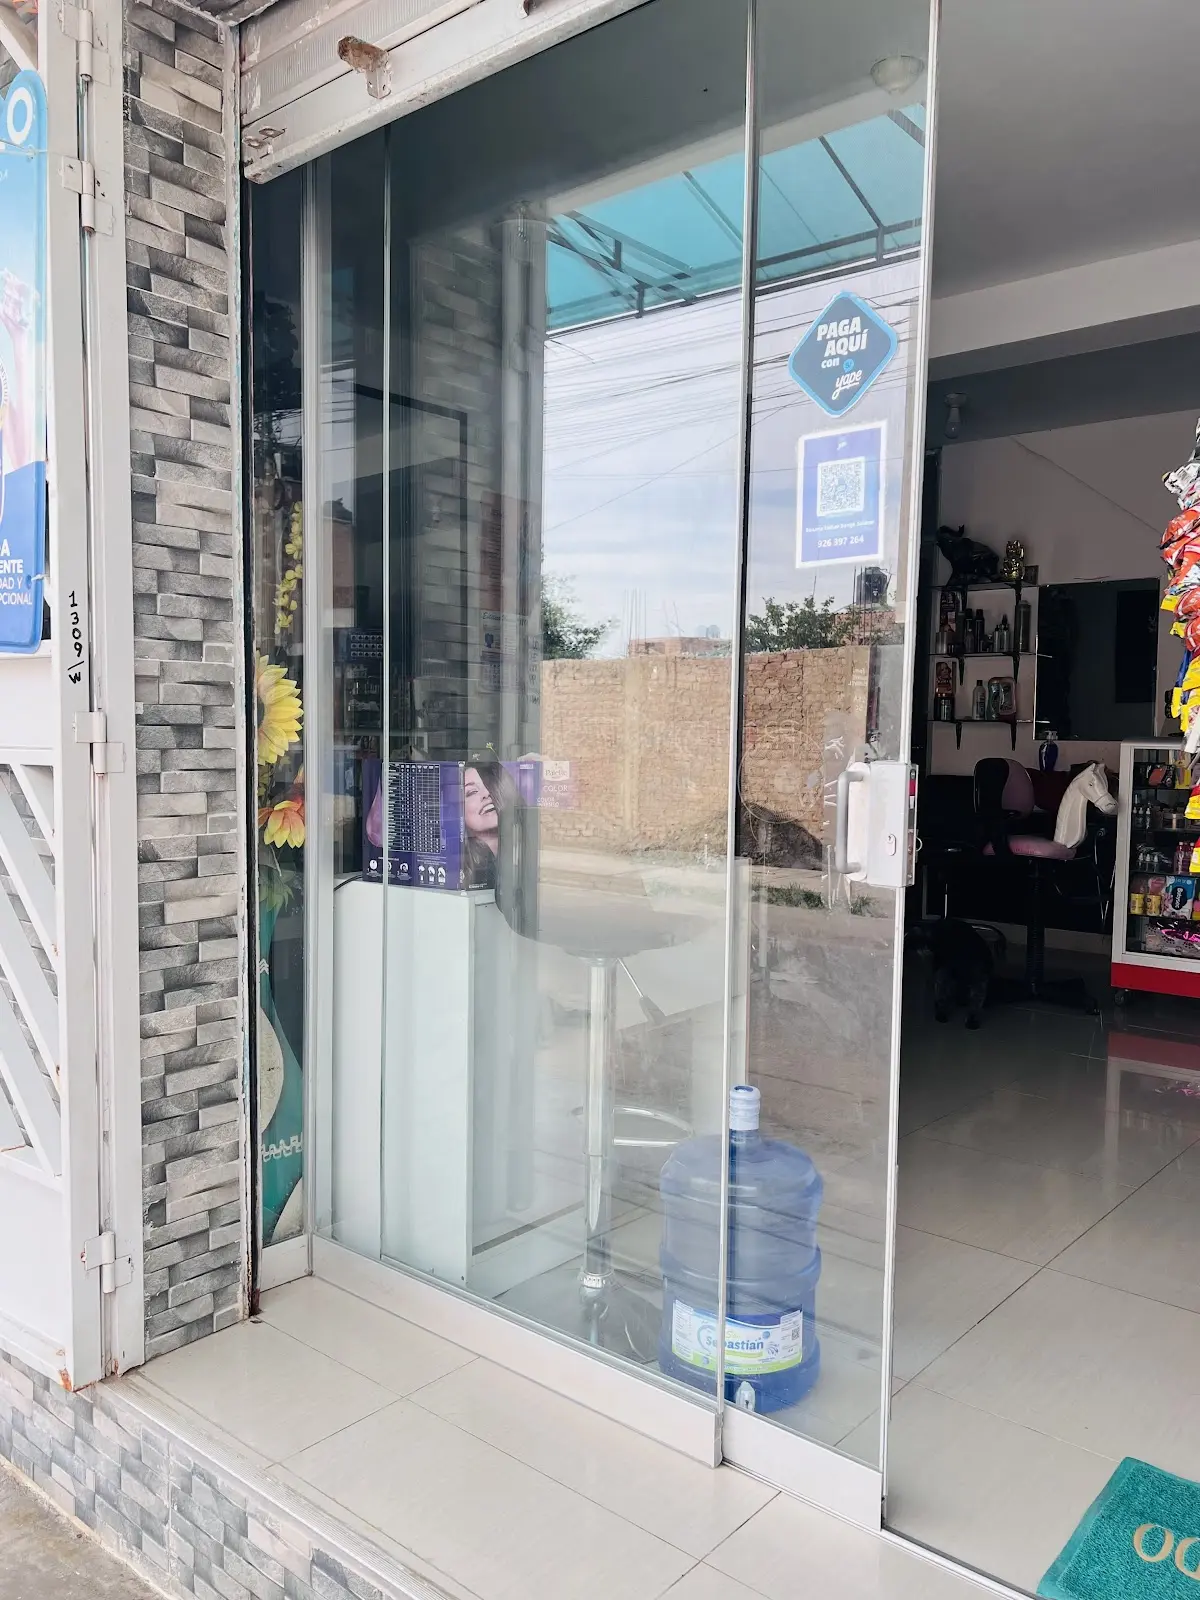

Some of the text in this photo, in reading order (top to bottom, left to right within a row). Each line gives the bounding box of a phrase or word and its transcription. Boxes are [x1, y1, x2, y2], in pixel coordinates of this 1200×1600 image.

[816, 316, 861, 341] PAGA
[823, 328, 869, 357] AQUÍ
[821, 357, 840, 369] con
[831, 369, 863, 400] yape
[16, 576, 23, 590] Y
